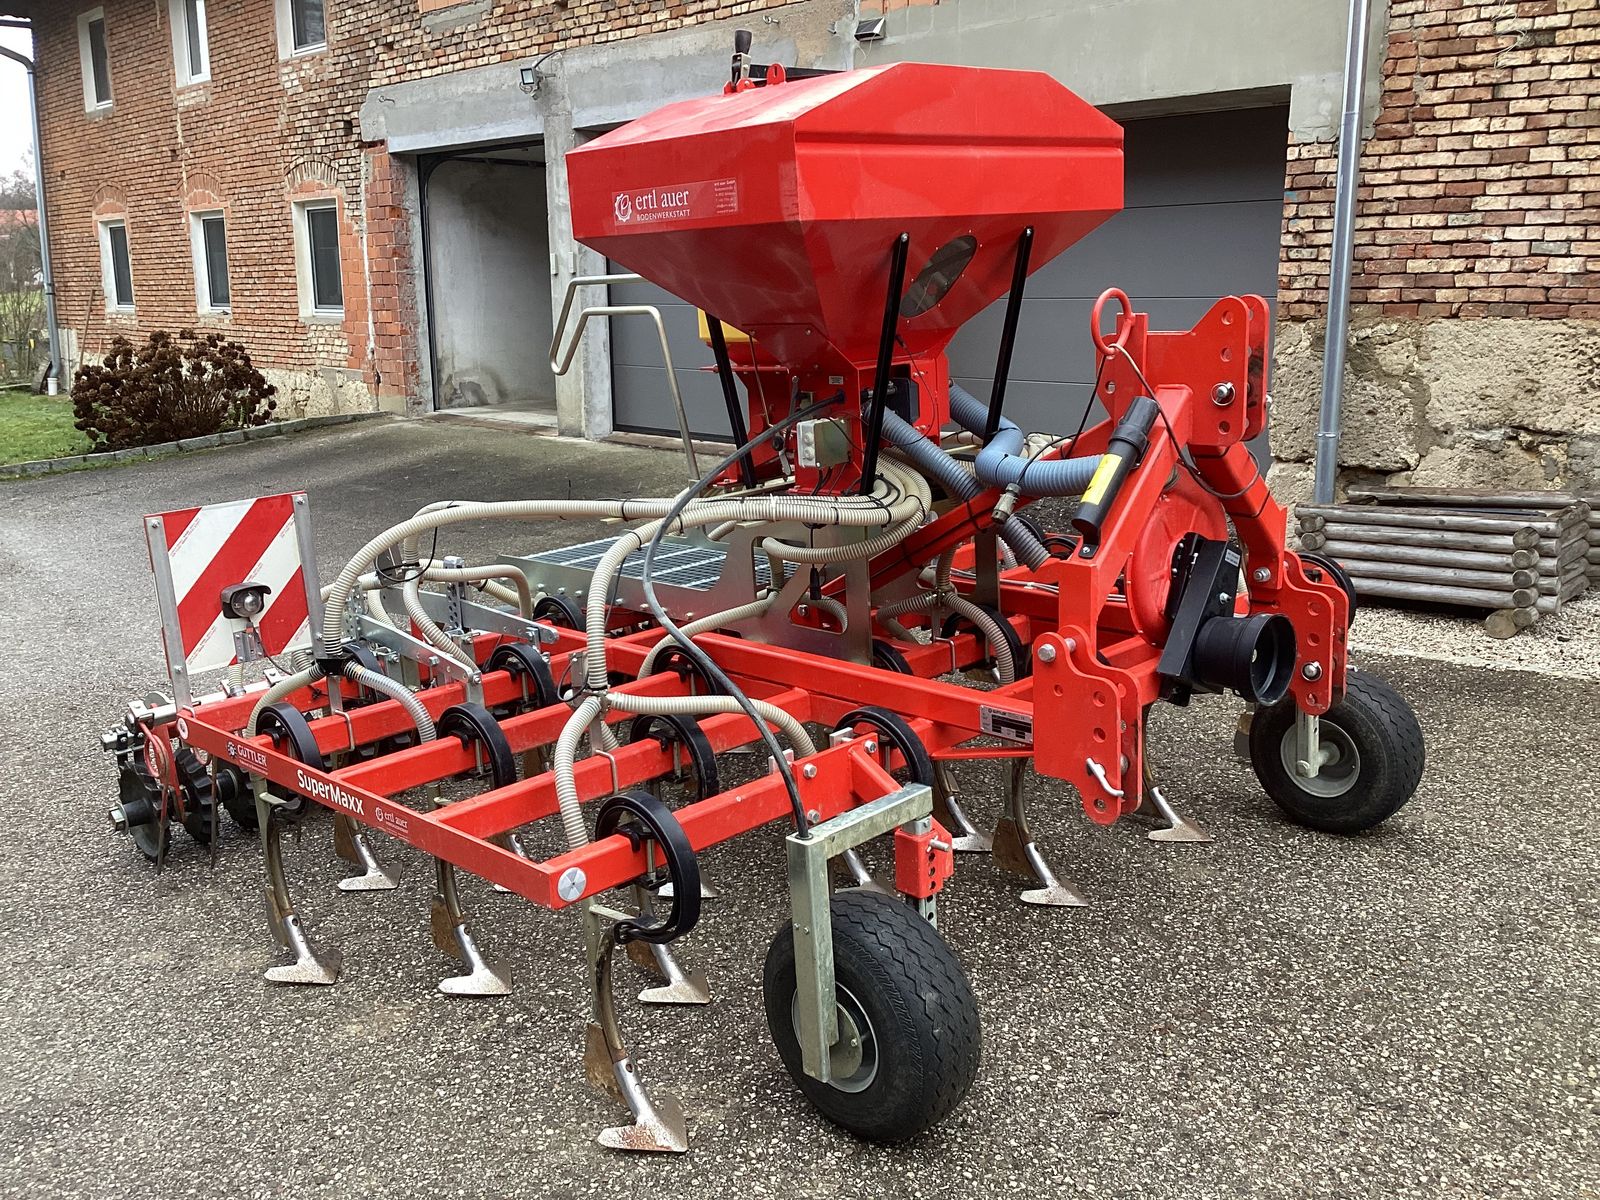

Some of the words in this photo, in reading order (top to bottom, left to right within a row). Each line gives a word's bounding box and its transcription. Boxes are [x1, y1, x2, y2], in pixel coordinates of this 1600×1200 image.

[635, 189, 656, 210] ertl
[661, 190, 689, 206] auer
[636, 209, 690, 221] BODENWERKSTATT
[297, 769, 364, 815] SuperMaxx
